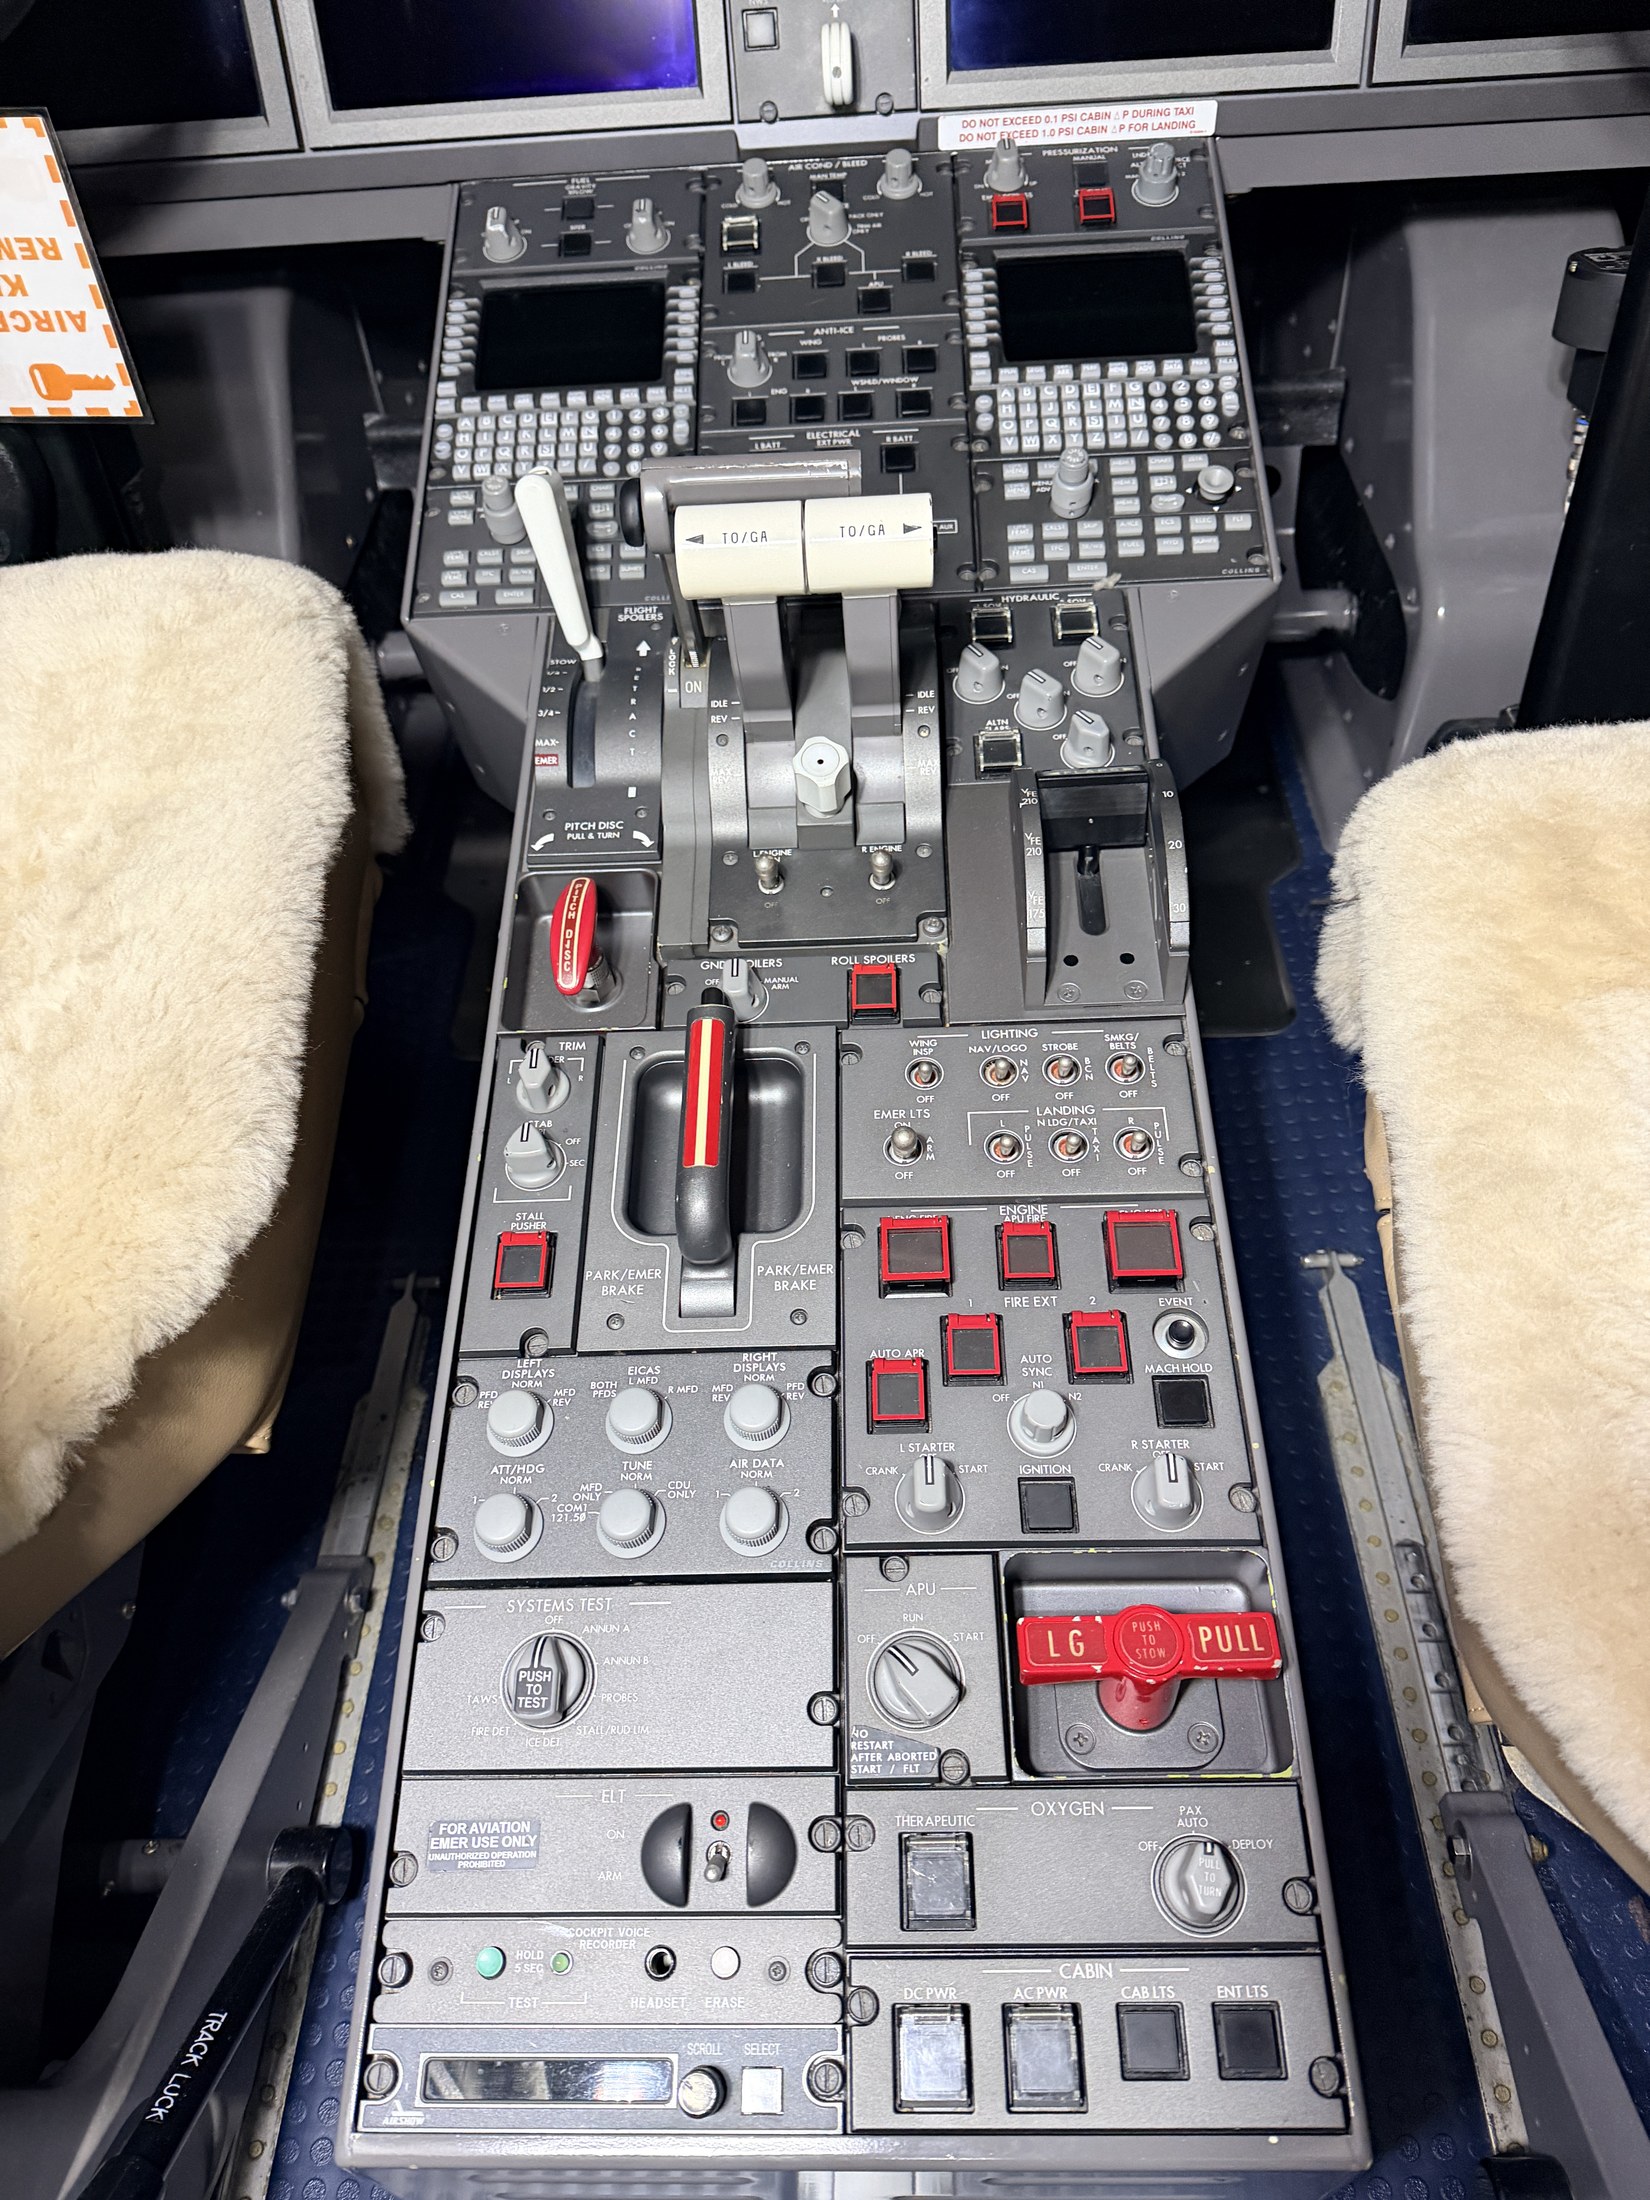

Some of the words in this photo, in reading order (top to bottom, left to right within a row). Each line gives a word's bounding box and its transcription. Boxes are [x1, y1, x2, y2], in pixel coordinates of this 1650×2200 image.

[962, 120, 976, 129] DO
[979, 118, 999, 128] NOT
[1003, 116, 1041, 126] EXCEED
[1044, 115, 1057, 124] 0.1
[1060, 114, 1077, 123] PSI
[1080, 112, 1110, 122] CABIN
[1132, 109, 1171, 118] DURING
[1174, 107, 1194, 116] TAXI
[959, 134, 974, 142] DO
[976, 132, 998, 141] NOT
[1042, 128, 1056, 137] 1.0
[1058, 127, 1074, 136] PSI
[1076, 125, 1108, 134] CABIN
[1128, 122, 1149, 132] FOR
[1151, 120, 1196, 130] LANDING
[1042, 147, 1118, 156] PRESSURIZATION
[806, 430, 860, 440] ELECTRICAL
[840, 524, 885, 537] TO/GA
[722, 531, 768, 543] TO/GA
[1001, 593, 1060, 603] HYDRAULIC
[618, 613, 663, 622] SPOILERS
[685, 681, 702, 693] ON
[565, 822, 596, 830] PITCH
[599, 821, 624, 829] DISC
[1168, 841, 1182, 849] 20
[1173, 904, 1186, 912] 30
[831, 956, 859, 964] ROLL
[863, 954, 916, 964] SPOILERS
[981, 1028, 1038, 1040] LIGHTING
[1104, 1033, 1139, 1042] SMKG/
[559, 1042, 586, 1050] TRIM
[969, 1044, 1027, 1053] NAV/LOGO
[1042, 1043, 1078, 1051] STROBE
[1110, 1042, 1136, 1050] BELTS
[874, 1110, 906, 1119] EMER
[910, 1109, 930, 1118] LTS
[1037, 1105, 1095, 1116] LANDING
[1048, 1118, 1096, 1126] LDG/TAXI
[1000, 1205, 1048, 1216] ENGINE
[511, 1222, 547, 1230] PUSHER
[586, 1269, 662, 1281] PARK/EMER
[602, 1285, 644, 1296] BRAKE
[1004, 1297, 1030, 1308] FIRE
[1034, 1297, 1057, 1307] EXT
[1159, 1297, 1193, 1306] EVENT
[870, 1349, 902, 1358] AUTO
[905, 1348, 925, 1358] APR
[517, 1359, 542, 1368] LEFT
[1020, 1354, 1052, 1364] AUTO
[502, 1369, 555, 1379] DISPLAYS
[628, 1366, 660, 1375] EICAS
[1022, 1367, 1052, 1376] SYNC
[1145, 1364, 1180, 1374] MACH
[1182, 1363, 1212, 1373] HOLD
[1132, 1440, 1138, 1449] R
[1141, 1439, 1190, 1449] STARTER
[491, 1464, 545, 1474] ATT/HDG
[730, 1459, 748, 1469] AIR
[753, 1458, 784, 1468] DATA
[1020, 1465, 1071, 1474] IGNITION
[668, 1481, 690, 1490] CDU
[668, 1490, 696, 1498] ONLY
[557, 1504, 587, 1512] COM1
[771, 1560, 823, 1568] COLLINS
[906, 1583, 936, 1595] APU
[507, 1599, 574, 1613] SYSTEMS
[580, 1598, 612, 1611] TEST
[582, 1624, 619, 1633] ANNUN
[622, 1624, 630, 1632] A
[1132, 1621, 1160, 1632] PUSH
[954, 1633, 984, 1641] START
[1143, 1635, 1155, 1645] TO
[1199, 1625, 1264, 1653] PULL
[1136, 1648, 1166, 1659] STOW
[519, 1671, 551, 1681] PUSH
[526, 1684, 542, 1695] TO
[518, 1697, 548, 1708] TEST
[851, 1741, 894, 1749] RESTART
[851, 1753, 882, 1762] AFTER
[887, 1752, 937, 1761] ABORTED
[601, 1789, 626, 1803] ELT
[1030, 1802, 1104, 1816] OXYGEN
[895, 1815, 974, 1827] THERAPEUTIC
[439, 1822, 467, 1835] FOR
[470, 1821, 530, 1834] AVIATION
[430, 1837, 469, 1849] EMER
[471, 1836, 499, 1848] USE
[502, 1835, 537, 1848] ONLY
[1232, 1839, 1272, 1850] DEPLOY
[568, 1928, 614, 1938] COCKPIT
[619, 1928, 650, 1938] VOICE
[579, 1939, 636, 1950] RECORDER
[1059, 1964, 1112, 1979] CABIN
[904, 1988, 921, 1999] DC
[924, 1988, 956, 1999] PWR
[1014, 1988, 1032, 1999] AC
[1037, 1988, 1068, 1999] PWR
[1122, 1987, 1148, 1998] CAB
[1150, 1986, 1174, 1998] LTS
[1217, 1986, 1242, 1998] ENT
[1245, 1986, 1268, 1997] LTS
[630, 1997, 686, 2008] HEADSET
[705, 1997, 744, 2008] ERASE
[181, 2012, 228, 2068] TRACK
[687, 2043, 722, 2055] SCROLL
[745, 2043, 780, 2055] SELECT
[145, 2073, 192, 2121] LUCK
